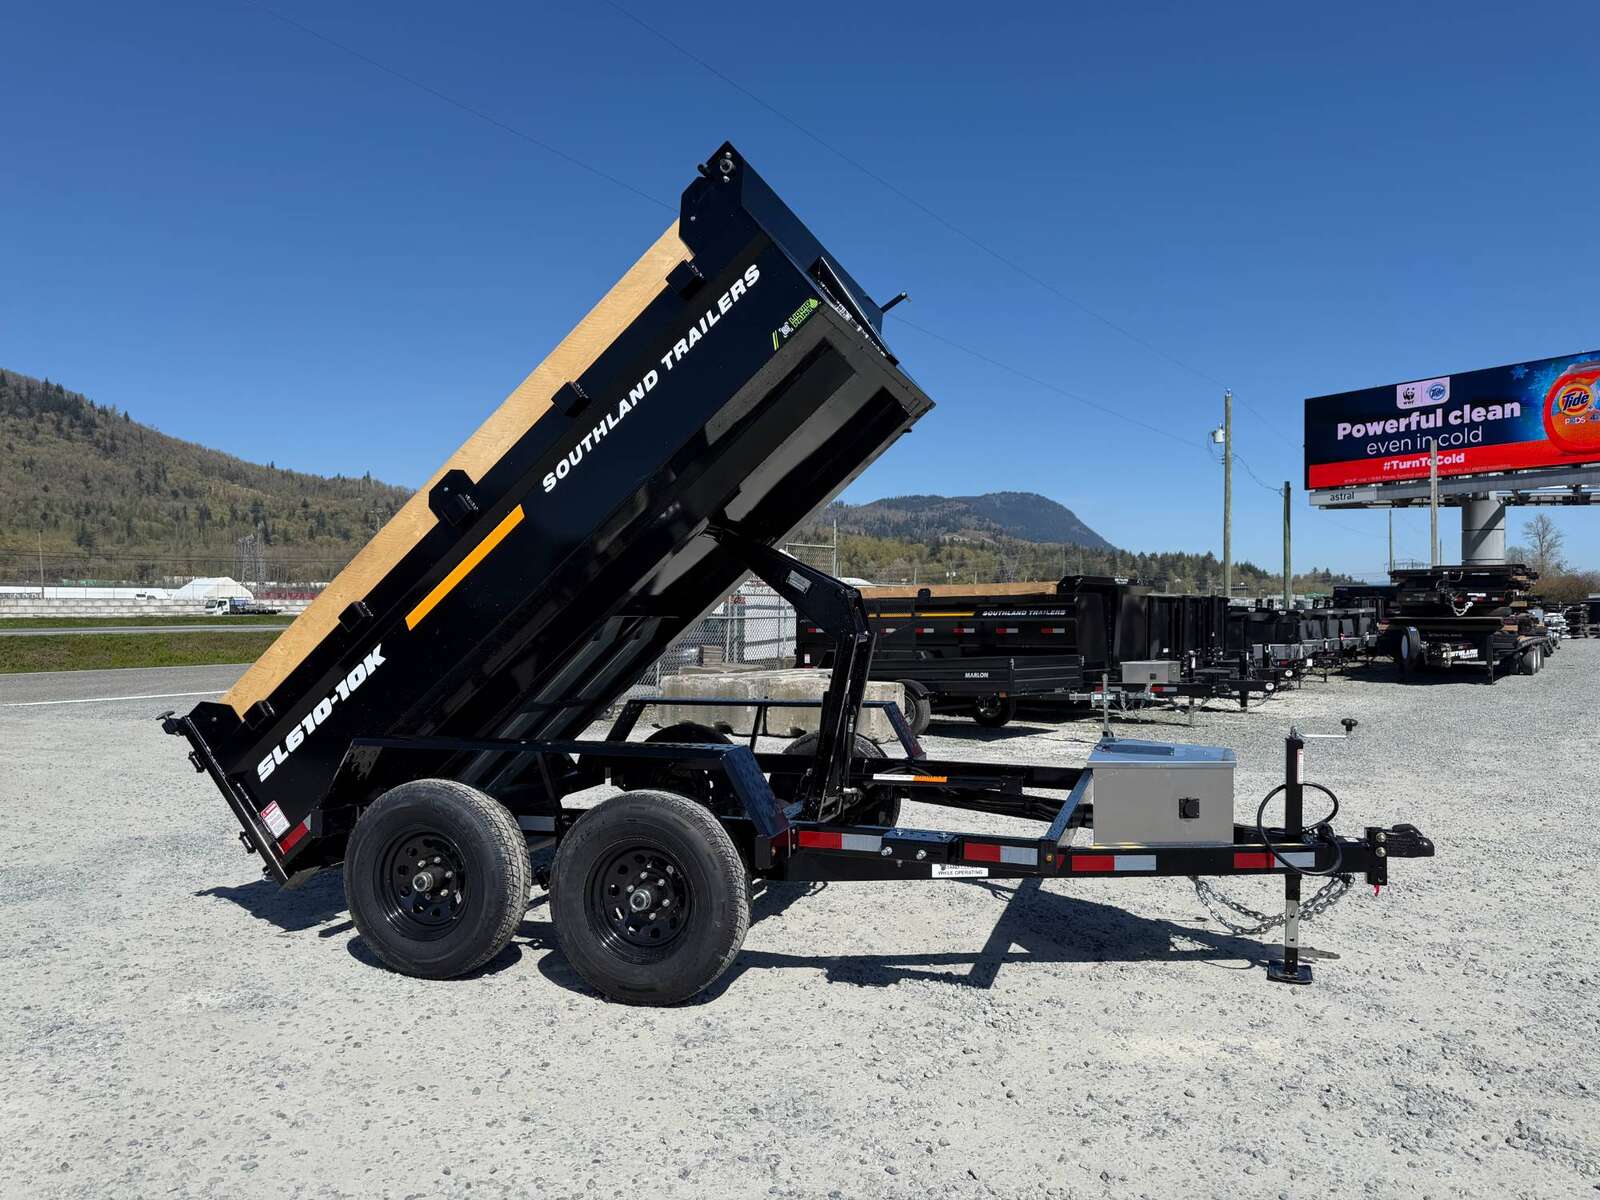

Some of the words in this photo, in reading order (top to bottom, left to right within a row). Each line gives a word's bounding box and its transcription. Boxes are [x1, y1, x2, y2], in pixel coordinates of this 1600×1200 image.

[542, 370, 658, 493] SOUTHLAND
[661, 264, 760, 371] TRAILERS
[1562, 391, 1590, 411] Tide
[1337, 408, 1443, 440] Powerful
[1448, 401, 1521, 425] clean
[1366, 438, 1411, 455] even
[1438, 425, 1483, 446] cold
[1329, 491, 1355, 501] astral
[256, 643, 386, 783] SL610-10K
